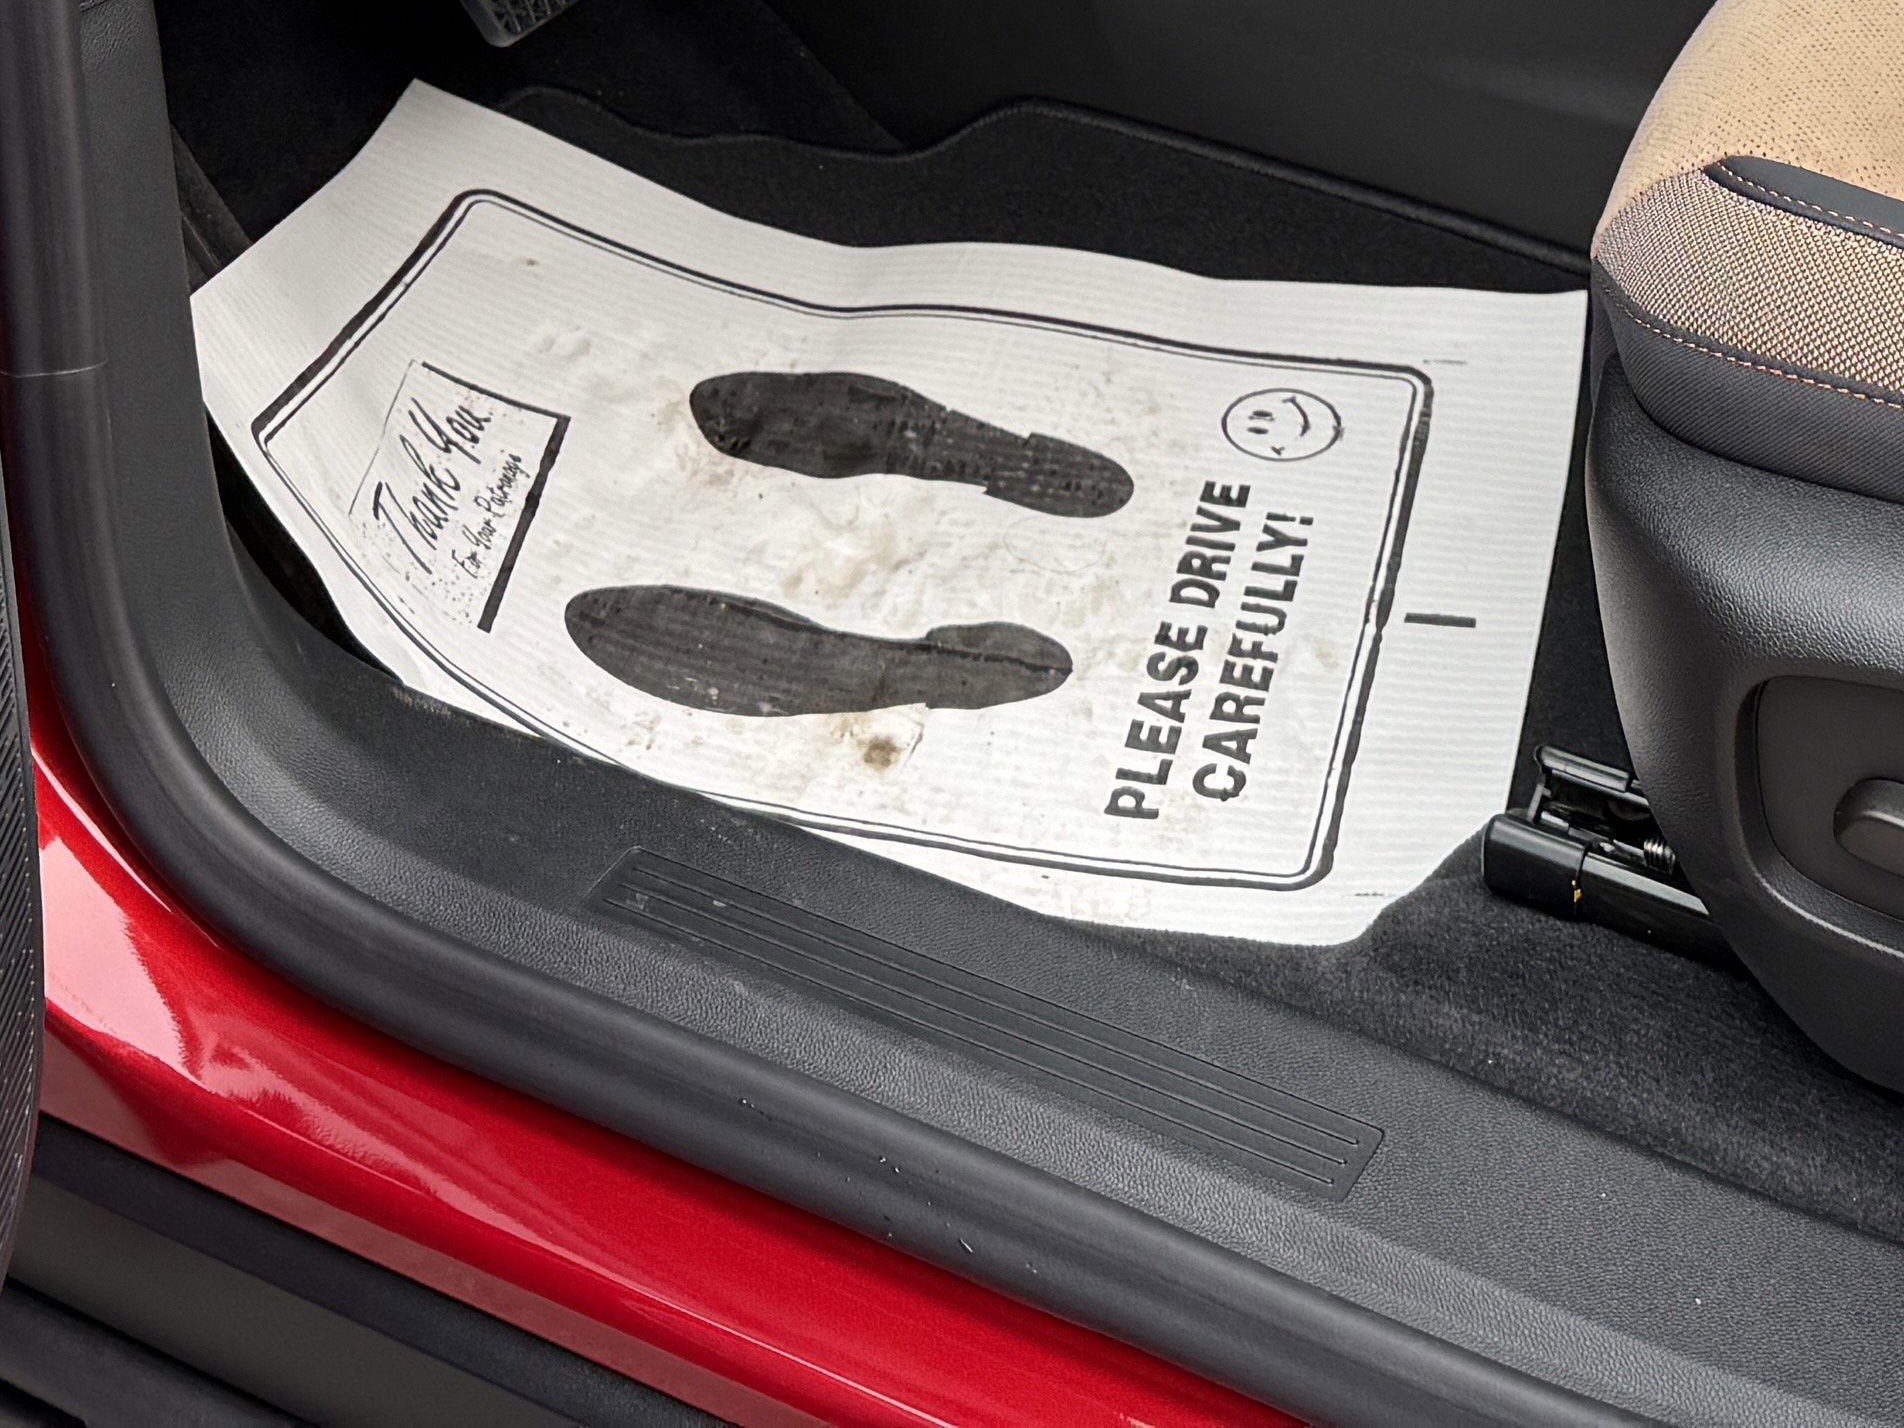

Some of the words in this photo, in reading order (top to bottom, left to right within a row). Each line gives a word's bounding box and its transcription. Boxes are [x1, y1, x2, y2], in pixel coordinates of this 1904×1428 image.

[408, 396, 492, 465] You
[372, 434, 461, 575] Thank
[462, 517, 497, 550] Your
[452, 549, 481, 579] For
[1103, 621, 1208, 820] PLEASE
[1169, 480, 1251, 609] DRIVE
[1192, 511, 1314, 802] CAREFULLY!
